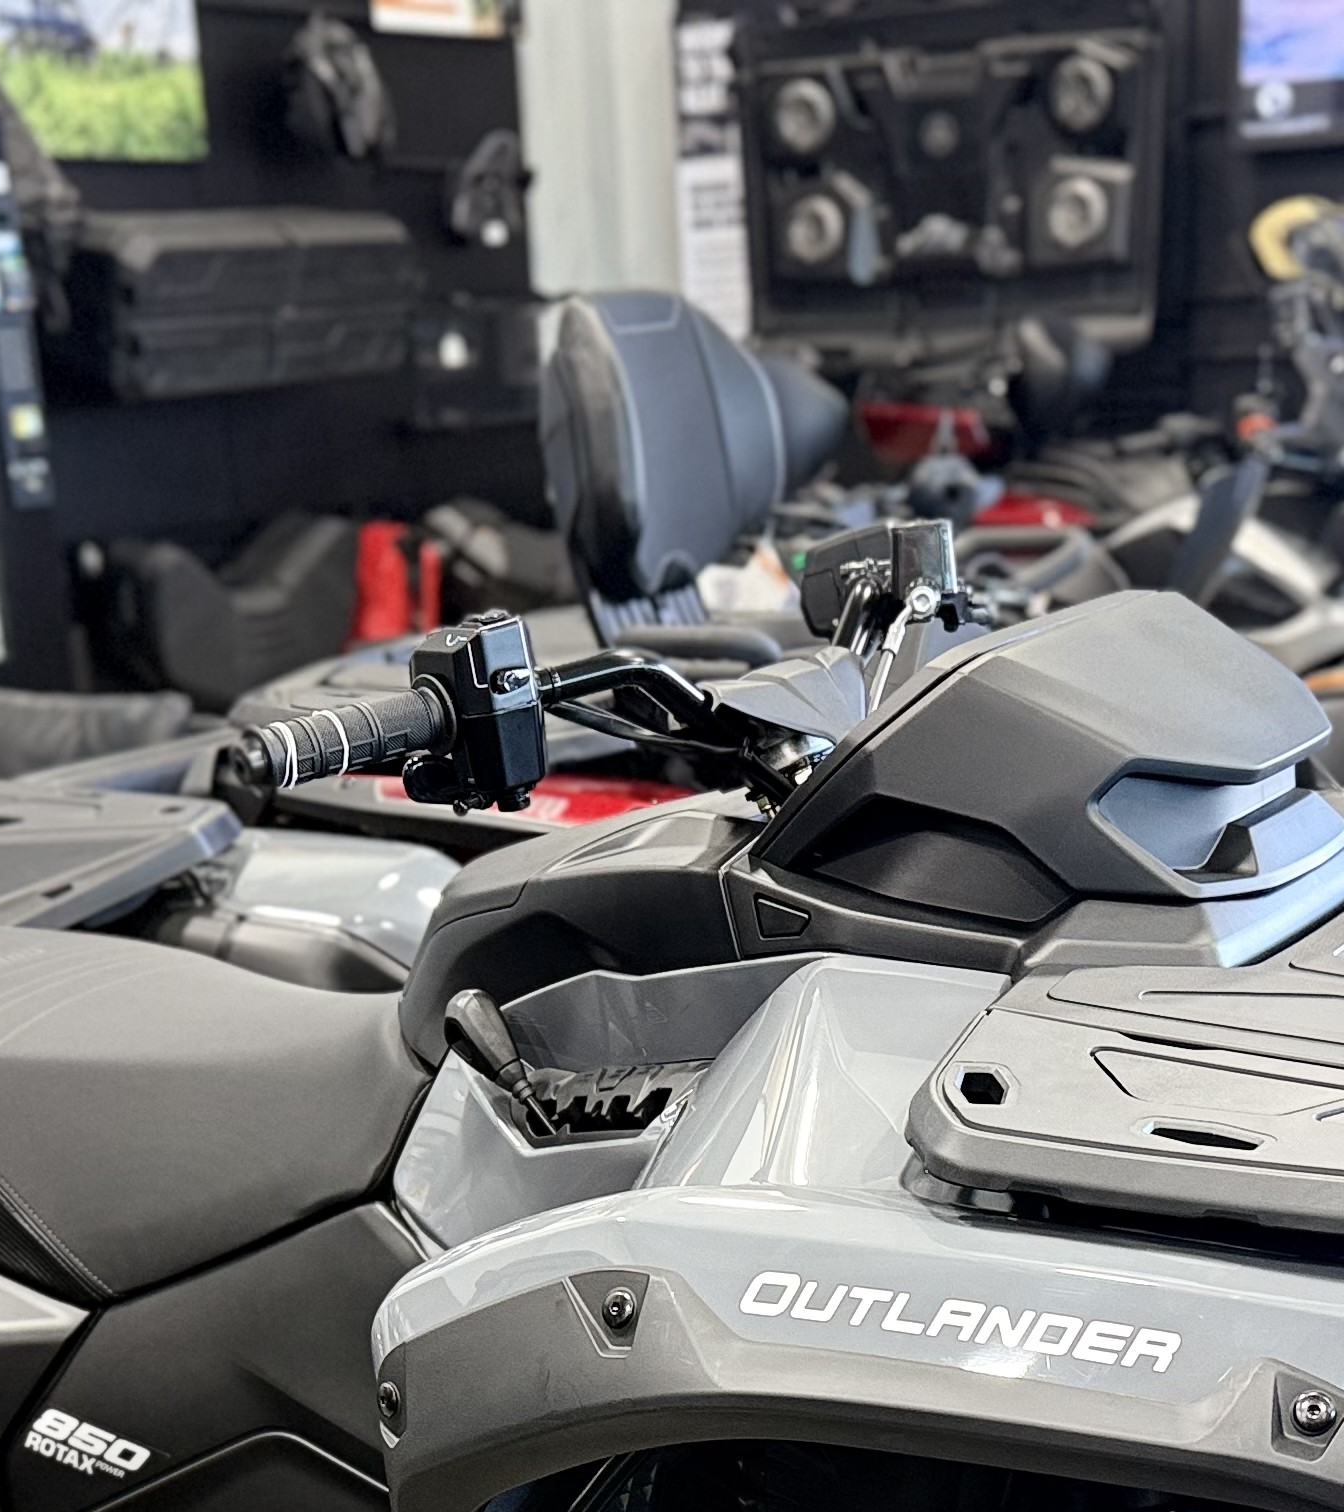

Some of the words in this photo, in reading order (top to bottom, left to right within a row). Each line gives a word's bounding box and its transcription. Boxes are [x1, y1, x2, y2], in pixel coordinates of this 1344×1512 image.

[738, 1269, 1182, 1374] OUTLANDER
[24, 1431, 97, 1475] ROTAX
[94, 1460, 125, 1478] POWER
[32, 1408, 151, 1471] 850
